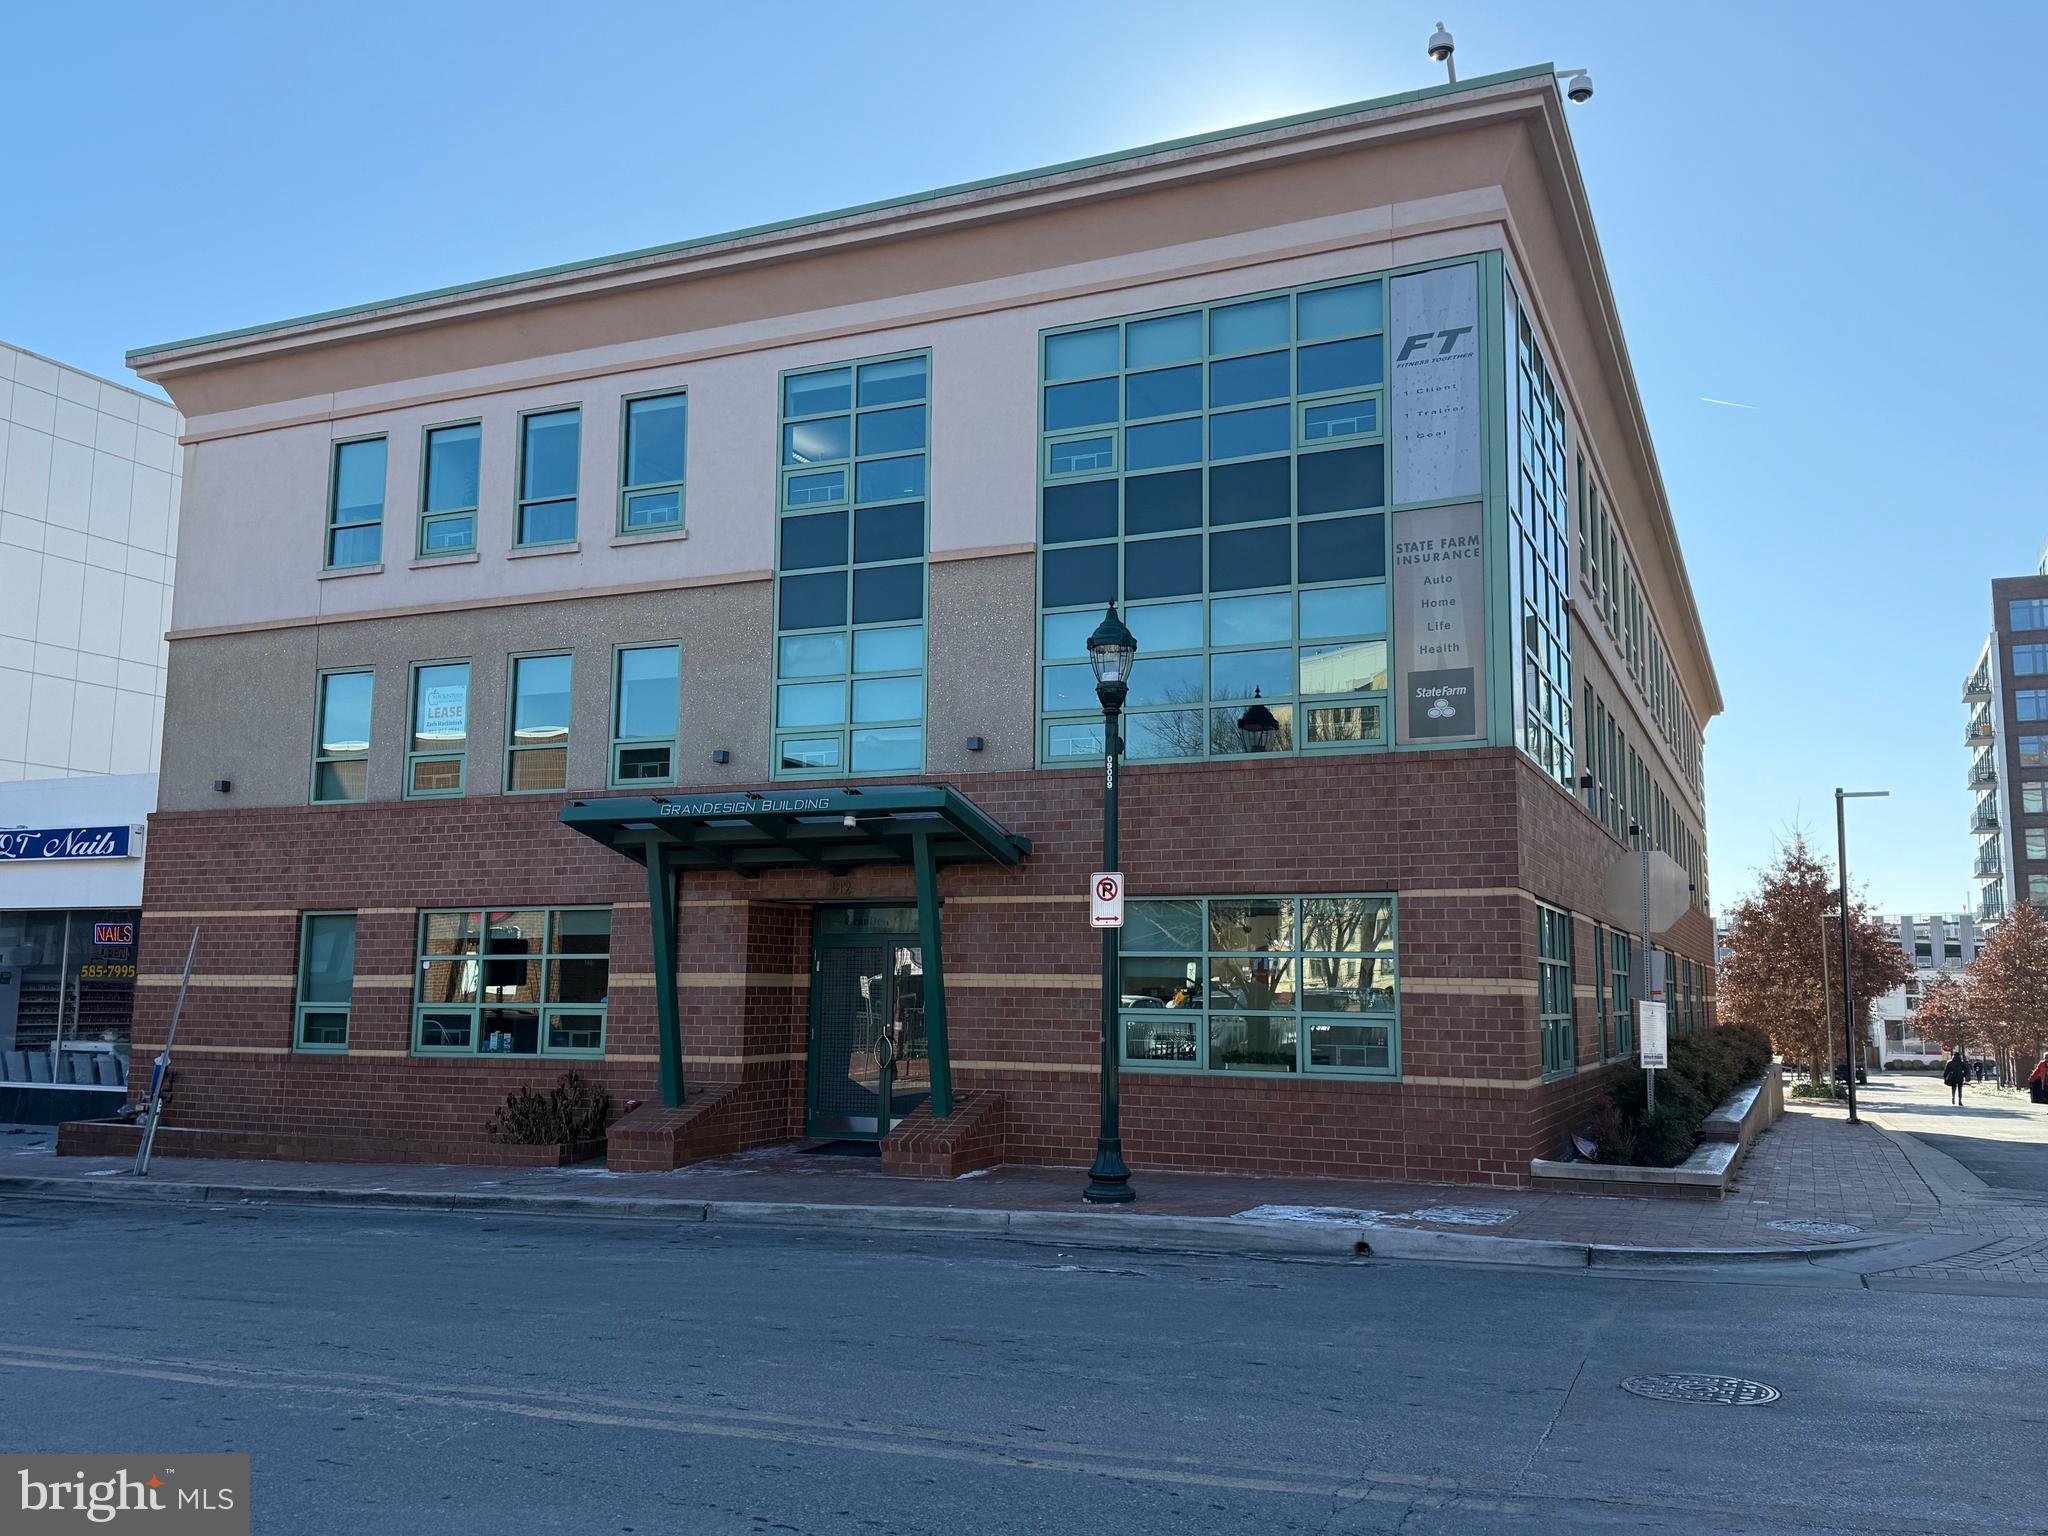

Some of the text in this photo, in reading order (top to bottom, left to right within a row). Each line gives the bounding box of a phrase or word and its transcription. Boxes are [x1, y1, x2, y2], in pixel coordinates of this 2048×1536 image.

[1396, 325, 1473, 362] FT
[1396, 352, 1475, 369] FITNESS TOGETHER
[1416, 384, 1457, 394] Client
[1416, 405, 1465, 417] Trainer
[1416, 430, 1447, 439] Goal
[1396, 535, 1480, 554] STATE FARM
[1396, 547, 1480, 566] INSURANCE
[1423, 575, 1453, 585] Auto
[1421, 598, 1456, 609] Home
[1427, 621, 1451, 632] Life
[1419, 642, 1460, 655] Health
[428, 706, 463, 719] LEASE
[660, 798, 830, 816] GRANDESIGN BUILDING
[43, 829, 115, 857] Nails
[96, 925, 132, 942] NAILS
[81, 964, 136, 978] 585-7995
